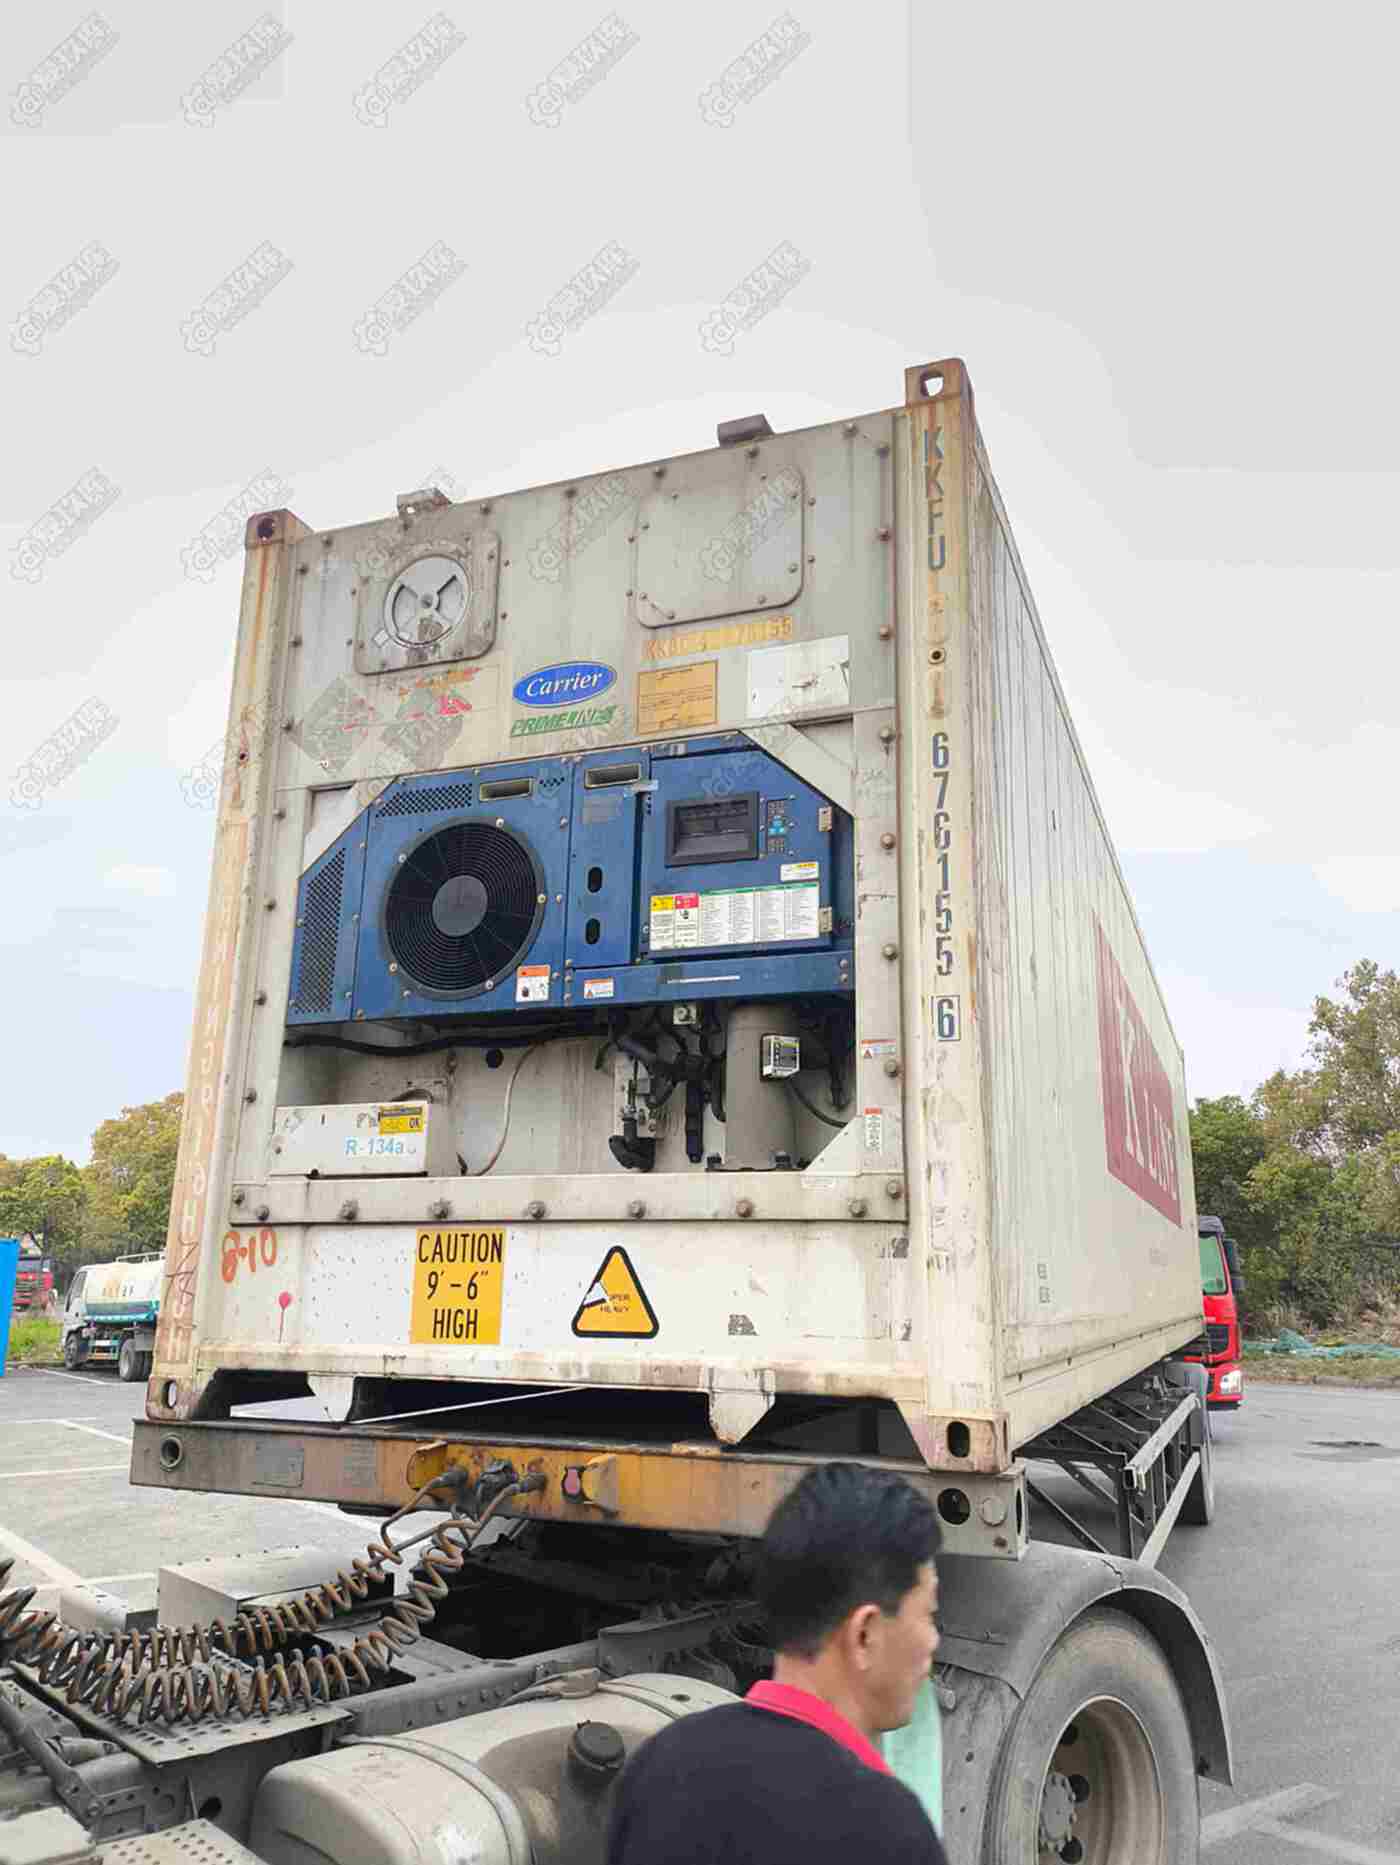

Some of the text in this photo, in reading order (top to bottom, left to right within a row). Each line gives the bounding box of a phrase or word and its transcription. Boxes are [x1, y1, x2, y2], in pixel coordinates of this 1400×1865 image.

[526, 671, 604, 697] Carrier
[936, 997, 956, 1039] 6
[345, 1137, 404, 1156] R-134a
[418, 1232, 503, 1263] CAUTION
[432, 1308, 479, 1339] HIGH
